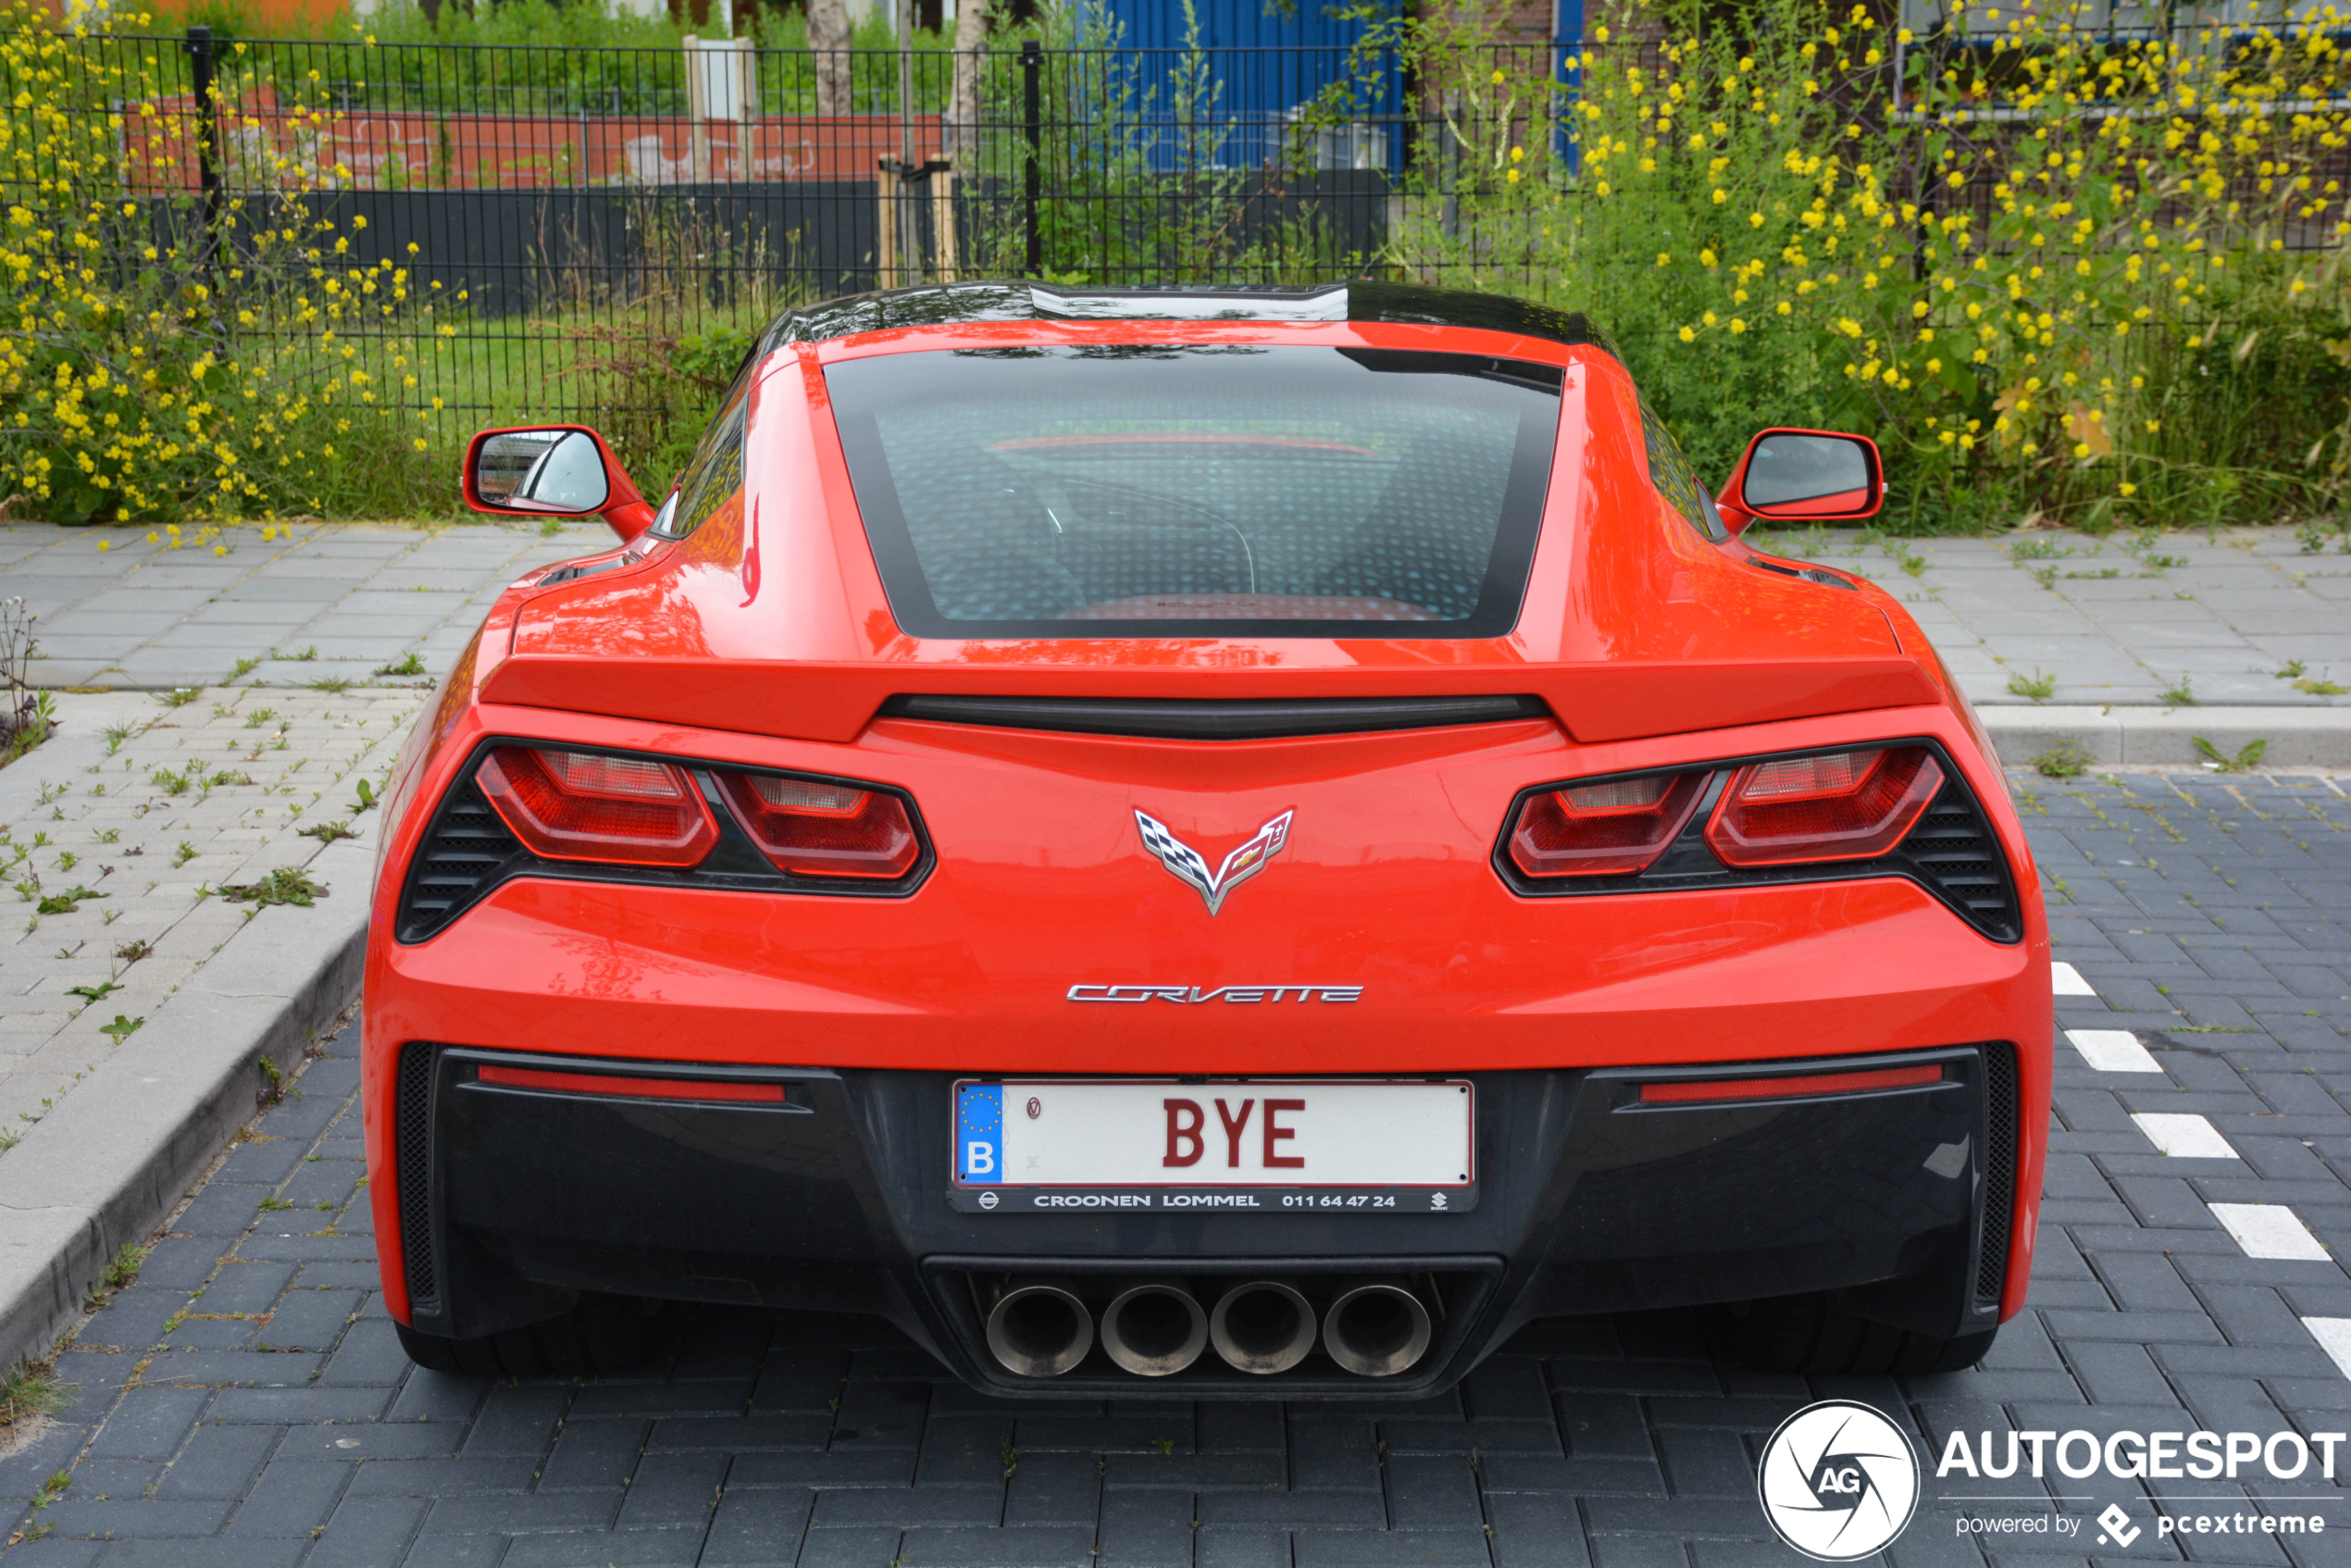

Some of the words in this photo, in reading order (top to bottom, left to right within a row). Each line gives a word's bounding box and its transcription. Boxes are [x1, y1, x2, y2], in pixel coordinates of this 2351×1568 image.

[1066, 984, 1364, 1004] CORVETTE
[1163, 1098, 1306, 1168] BYE
[967, 1141, 994, 1174] B
[1034, 1195, 1151, 1207] CROONEN
[1163, 1195, 1261, 1207] LOMMEL
[1282, 1195, 1314, 1207] 011
[1320, 1195, 1343, 1207] 64
[1346, 1195, 1369, 1207] 47
[1373, 1195, 1396, 1207] 24
